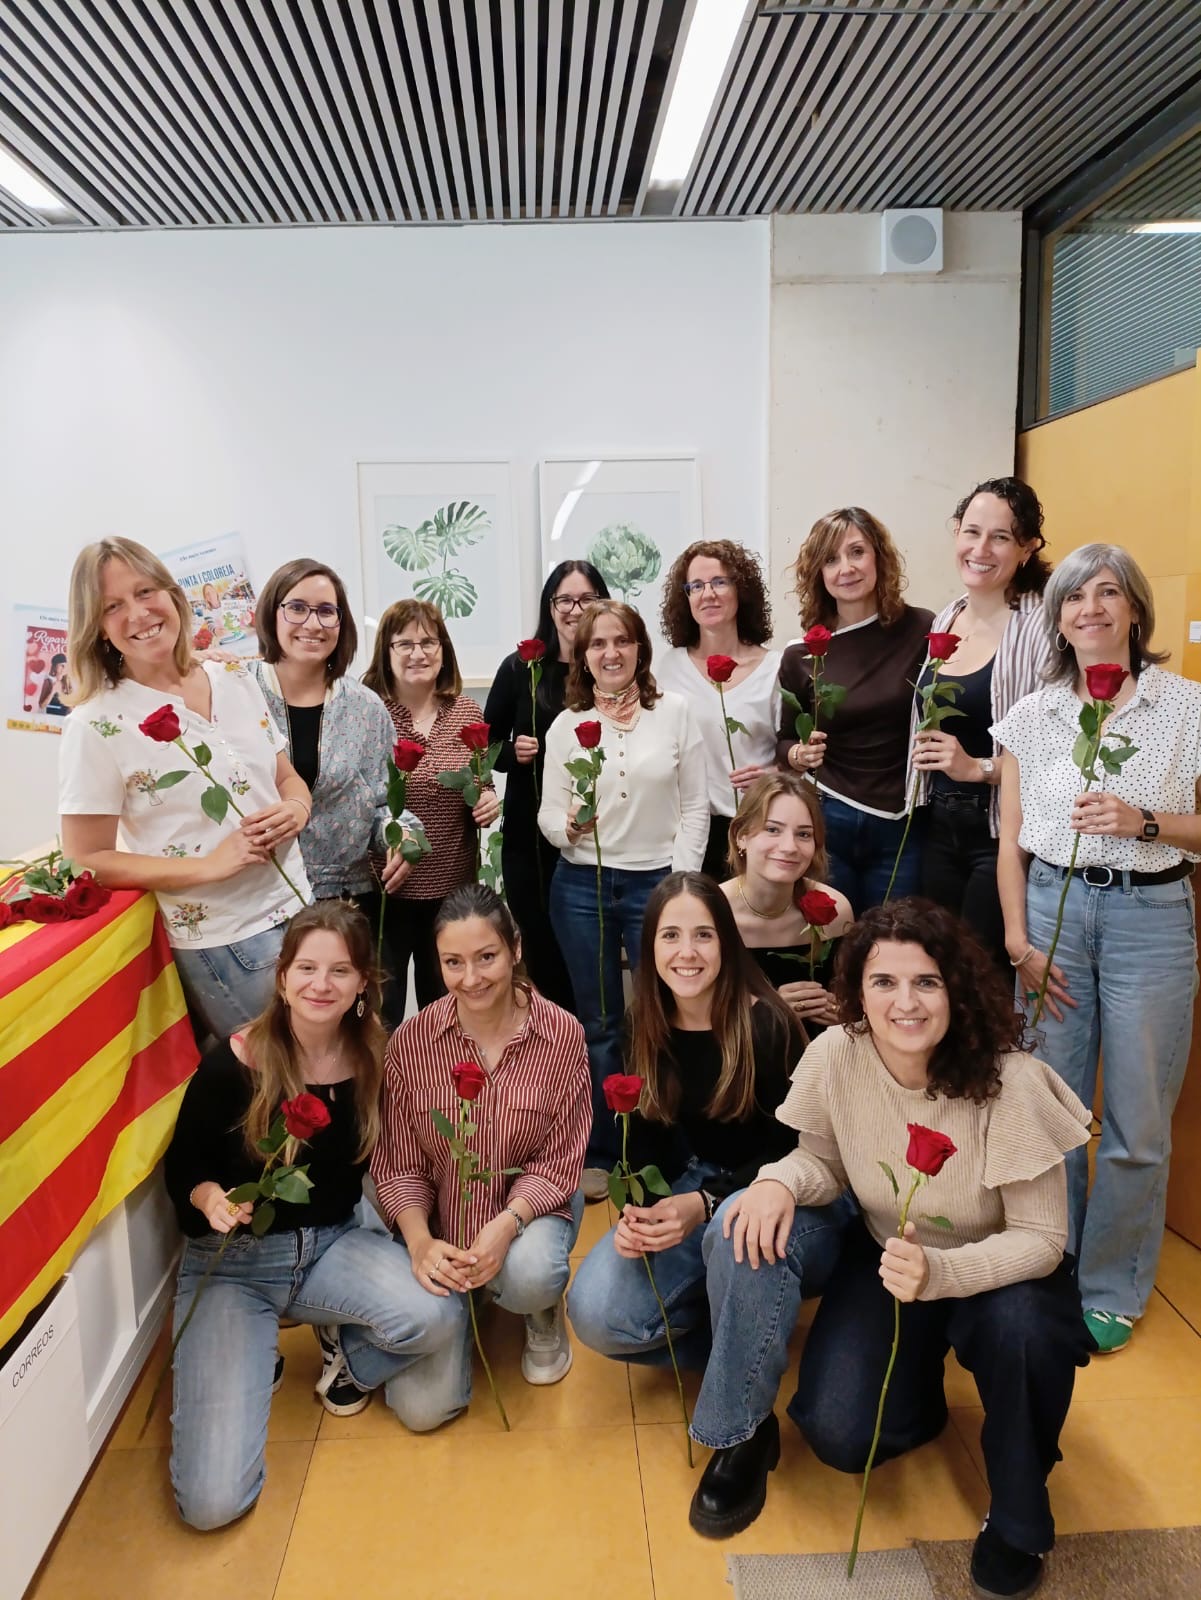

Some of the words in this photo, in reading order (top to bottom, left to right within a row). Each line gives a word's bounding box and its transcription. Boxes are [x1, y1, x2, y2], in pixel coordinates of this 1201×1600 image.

[178, 574, 199, 588] PINTA
[201, 564, 235, 583] COLOREJA
[12, 1324, 54, 1388] CORREOS
